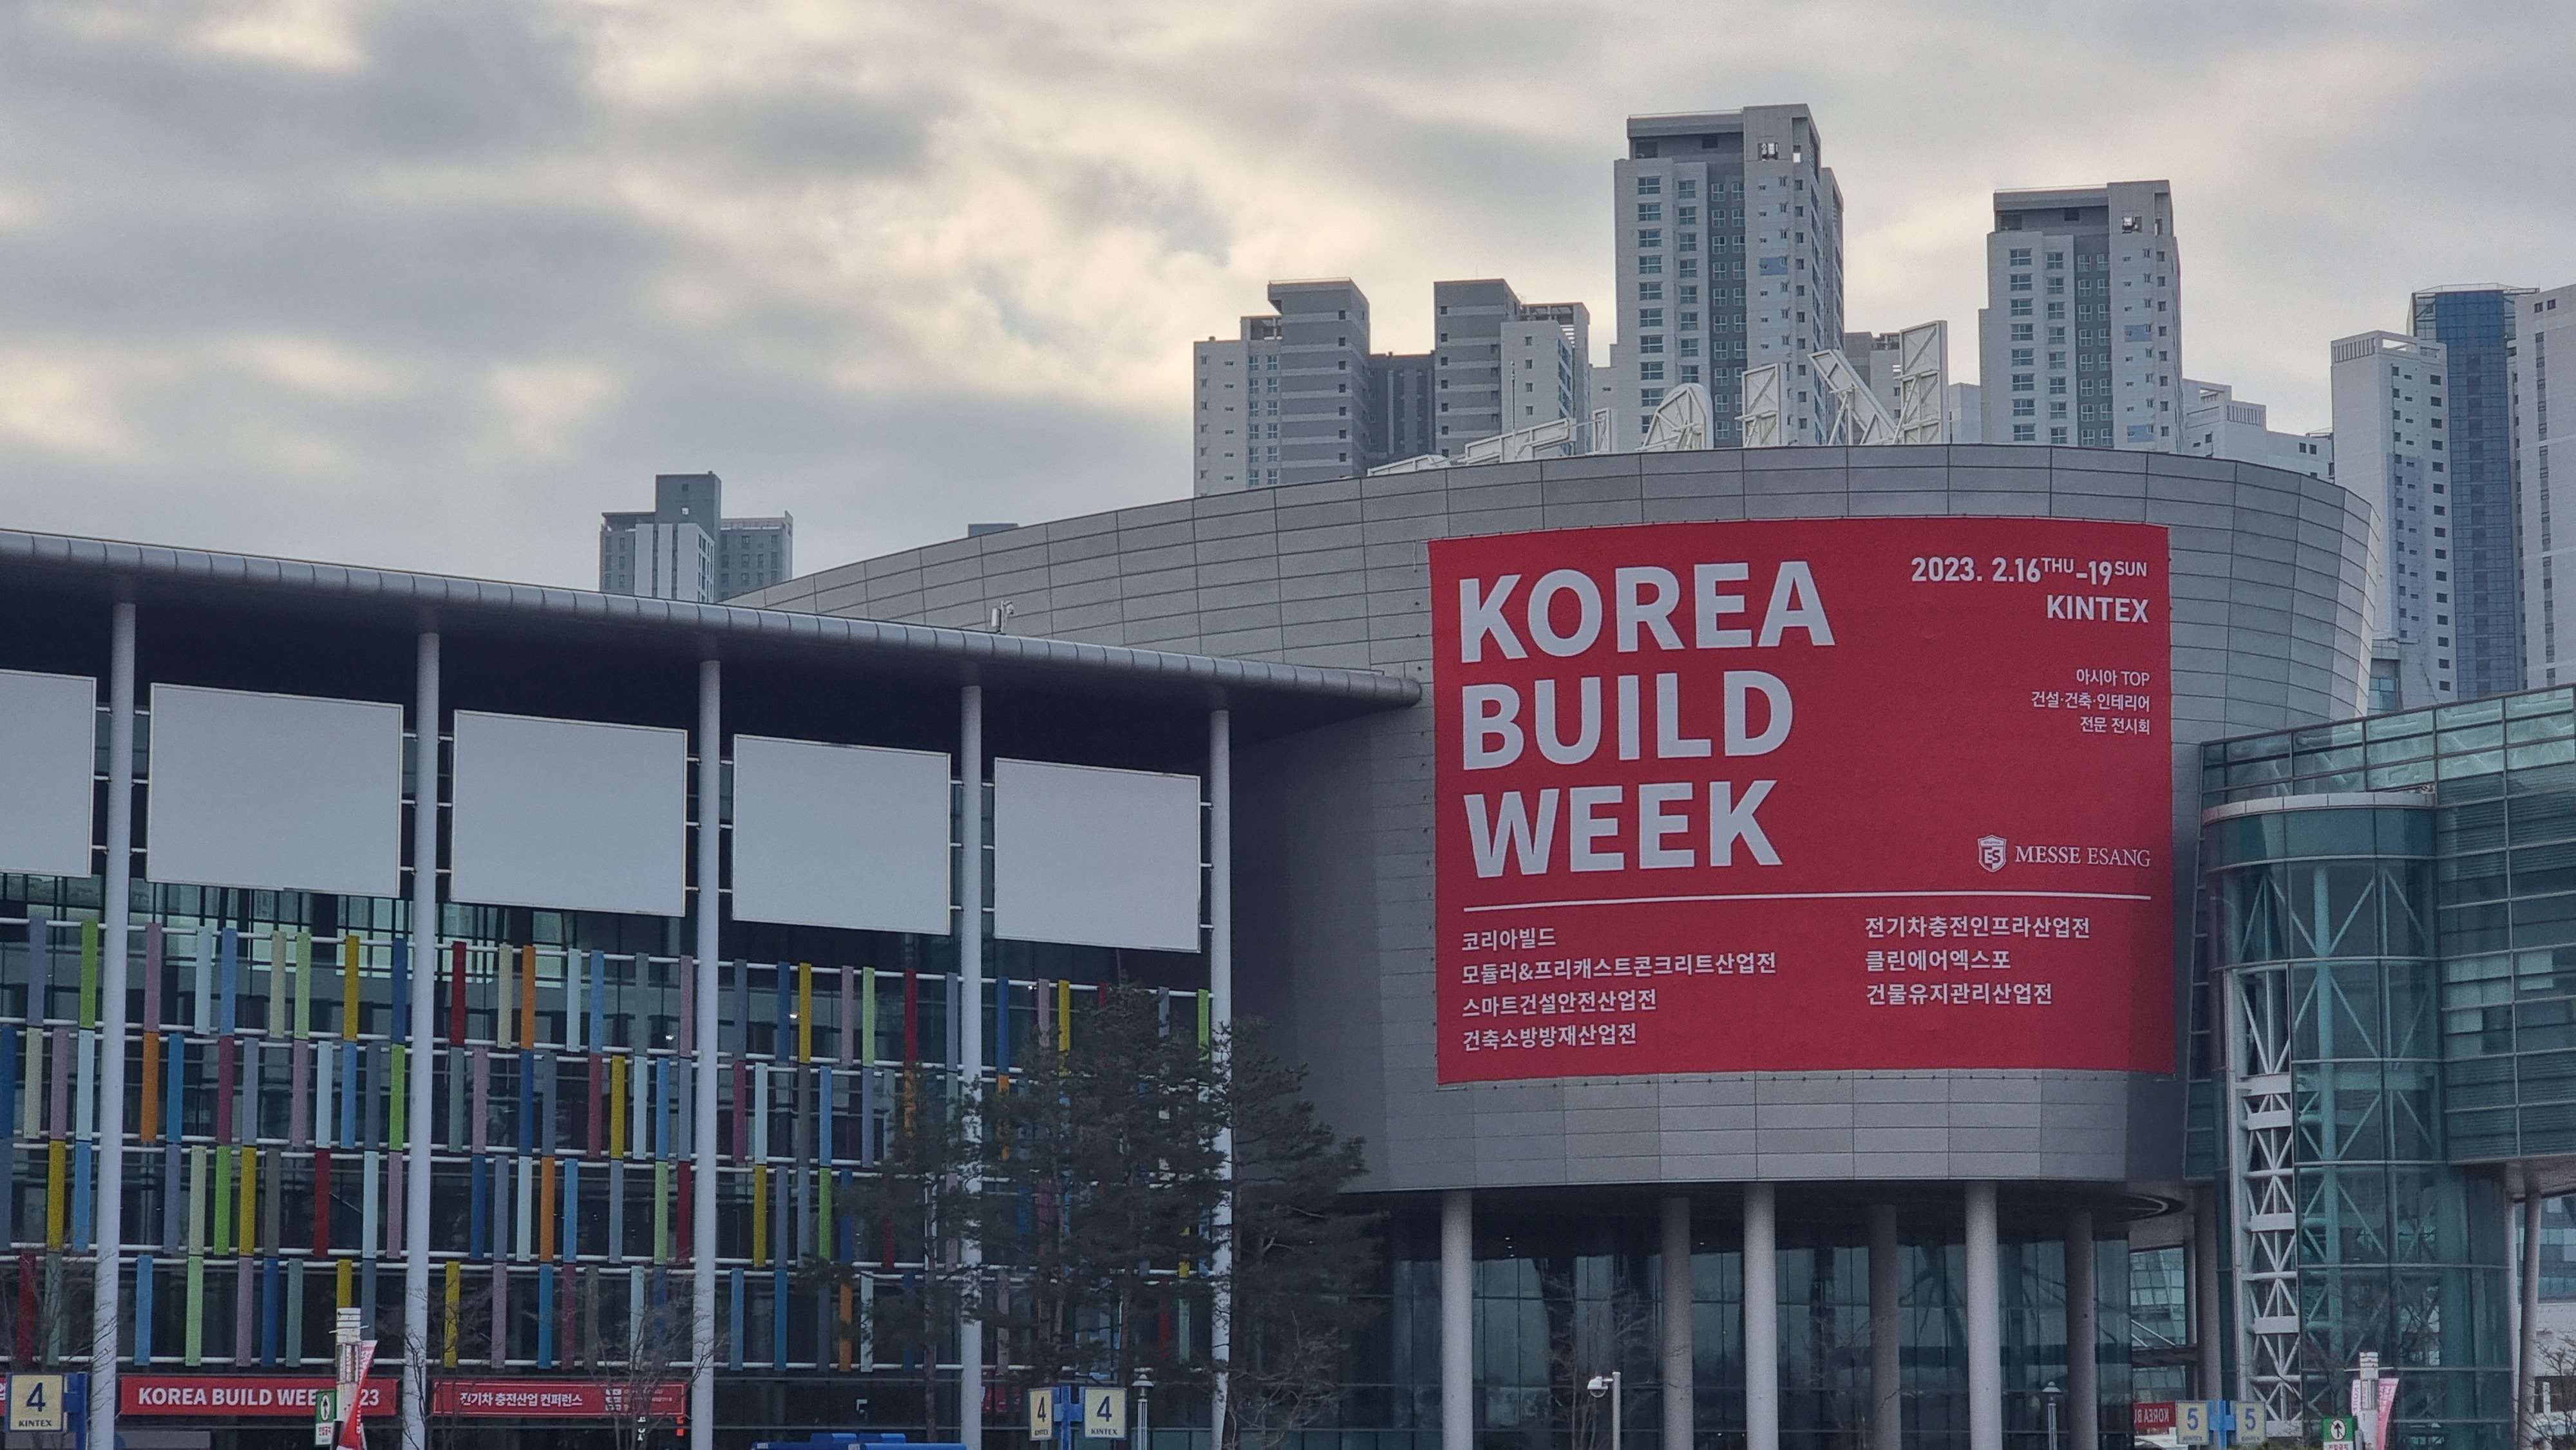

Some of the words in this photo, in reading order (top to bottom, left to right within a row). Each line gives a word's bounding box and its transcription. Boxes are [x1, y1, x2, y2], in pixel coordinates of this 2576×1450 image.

[1912, 557, 1982, 581] 2023.
[1460, 561, 1835, 663] KOREA
[2048, 595, 2148, 623] KINTEX
[2077, 669, 2117, 686] 아시아
[2121, 672, 2150, 686] TOP
[1463, 671, 1792, 770] BUILD
[2081, 717, 2107, 732] 전문
[2112, 718, 2150, 735] 전시회
[1464, 780, 1782, 878] WEEK
[2015, 846, 2081, 863] MESSE
[2087, 848, 2150, 866] ESANG
[1866, 916, 2088, 938] 전기차충전인프라산업전
[1462, 928, 1556, 950] 코리아빌드
[1462, 952, 1776, 984] 모듈러&프리캐스트콘크리트산업전
[1866, 950, 2011, 971] 클린에어엑스포
[1463, 989, 1656, 1017] 스마트건설안전산업전
[1867, 983, 2051, 1004] 건물유지관리산업전
[1464, 1023, 1635, 1051] 건축소방방재산업전
[26, 1382, 46, 1412] 4
[139, 1388, 206, 1404] KOREA
[213, 1389, 272, 1405] BUILD
[277, 1389, 316, 1406] WEE
[495, 1393, 538, 1406] 충전산업
[541, 1393, 582, 1406] 컨퍼런스
[1037, 1397, 1046, 1422] 4
[1097, 1396, 1112, 1422] 4
[2188, 1408, 2199, 1430] 5
[2245, 1408, 2256, 1431] 5
